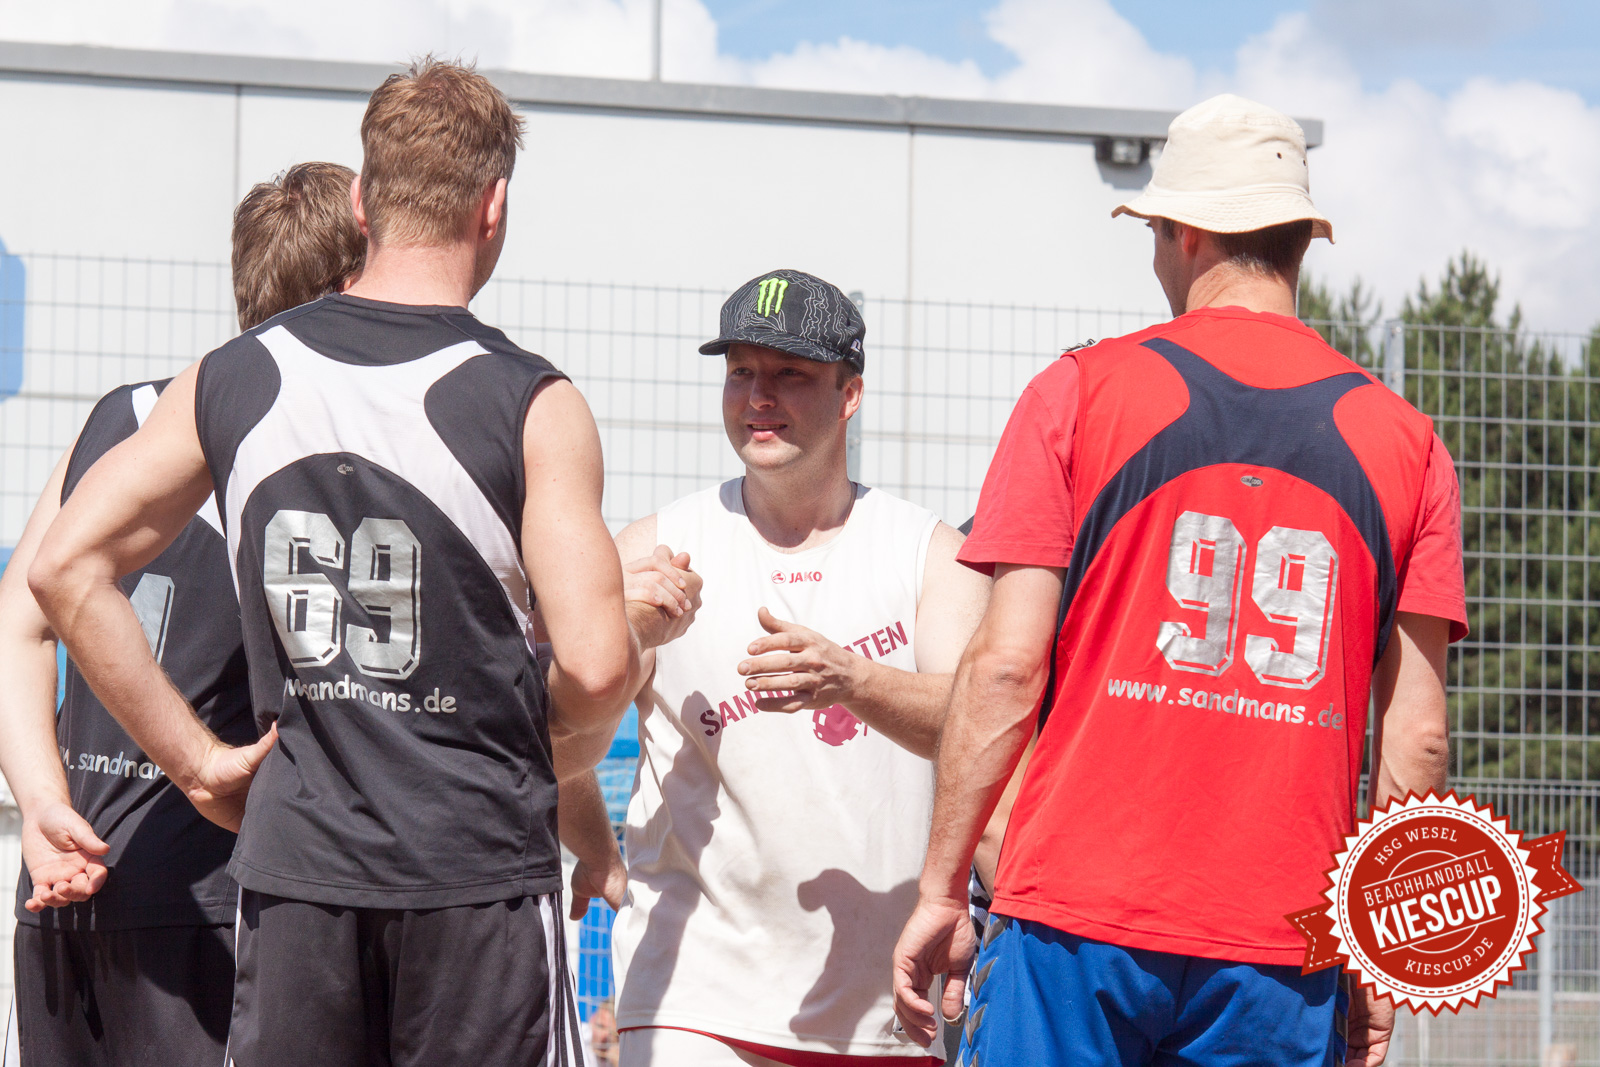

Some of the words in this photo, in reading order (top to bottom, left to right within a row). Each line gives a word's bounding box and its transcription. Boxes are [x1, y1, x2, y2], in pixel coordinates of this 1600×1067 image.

[264, 509, 422, 680] 69
[789, 571, 822, 584] JAKO
[1156, 510, 1339, 690] 99
[1107, 679, 1343, 730] www.sandmans.de
